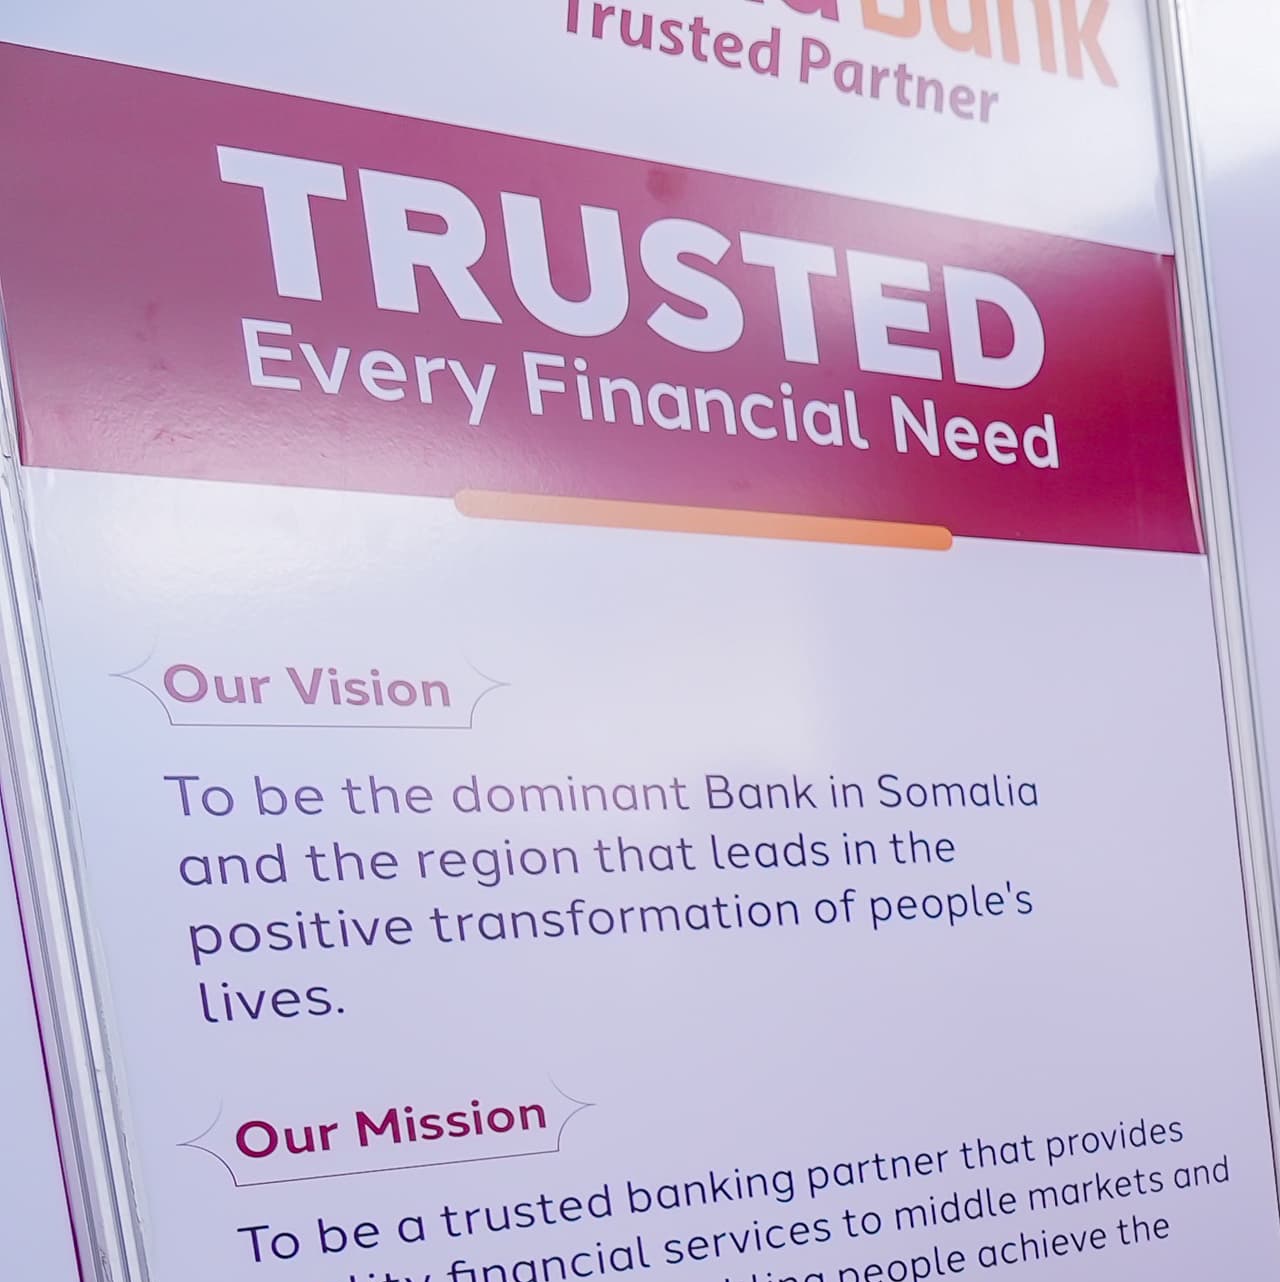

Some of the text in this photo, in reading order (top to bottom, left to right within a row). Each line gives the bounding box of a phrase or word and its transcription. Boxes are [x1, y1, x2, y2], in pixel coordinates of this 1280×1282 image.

[800, 37, 998, 122] Partner
[217, 146, 1047, 389] TRUSTED
[242, 317, 1058, 468] Every Financial Need
[164, 664, 450, 707] Our Vision
[164, 774, 1038, 816] To be the dominant Bank in Somalia
[180, 831, 955, 887] and the region that leads in the
[190, 881, 1032, 965] positive transformation of people's
[200, 982, 344, 1023] lives.
[236, 1100, 546, 1158] Our Mission
[237, 1118, 1183, 1262] To be a trusted banking partner that provides
[665, 1219, 831, 1264] services
[842, 1210, 881, 1237] to
[896, 1188, 1016, 1230] middle
[1029, 1169, 1163, 1210] markets
[1174, 1155, 1229, 1188] and
[979, 1229, 1106, 1268] achieve
[1117, 1215, 1169, 1245] the
